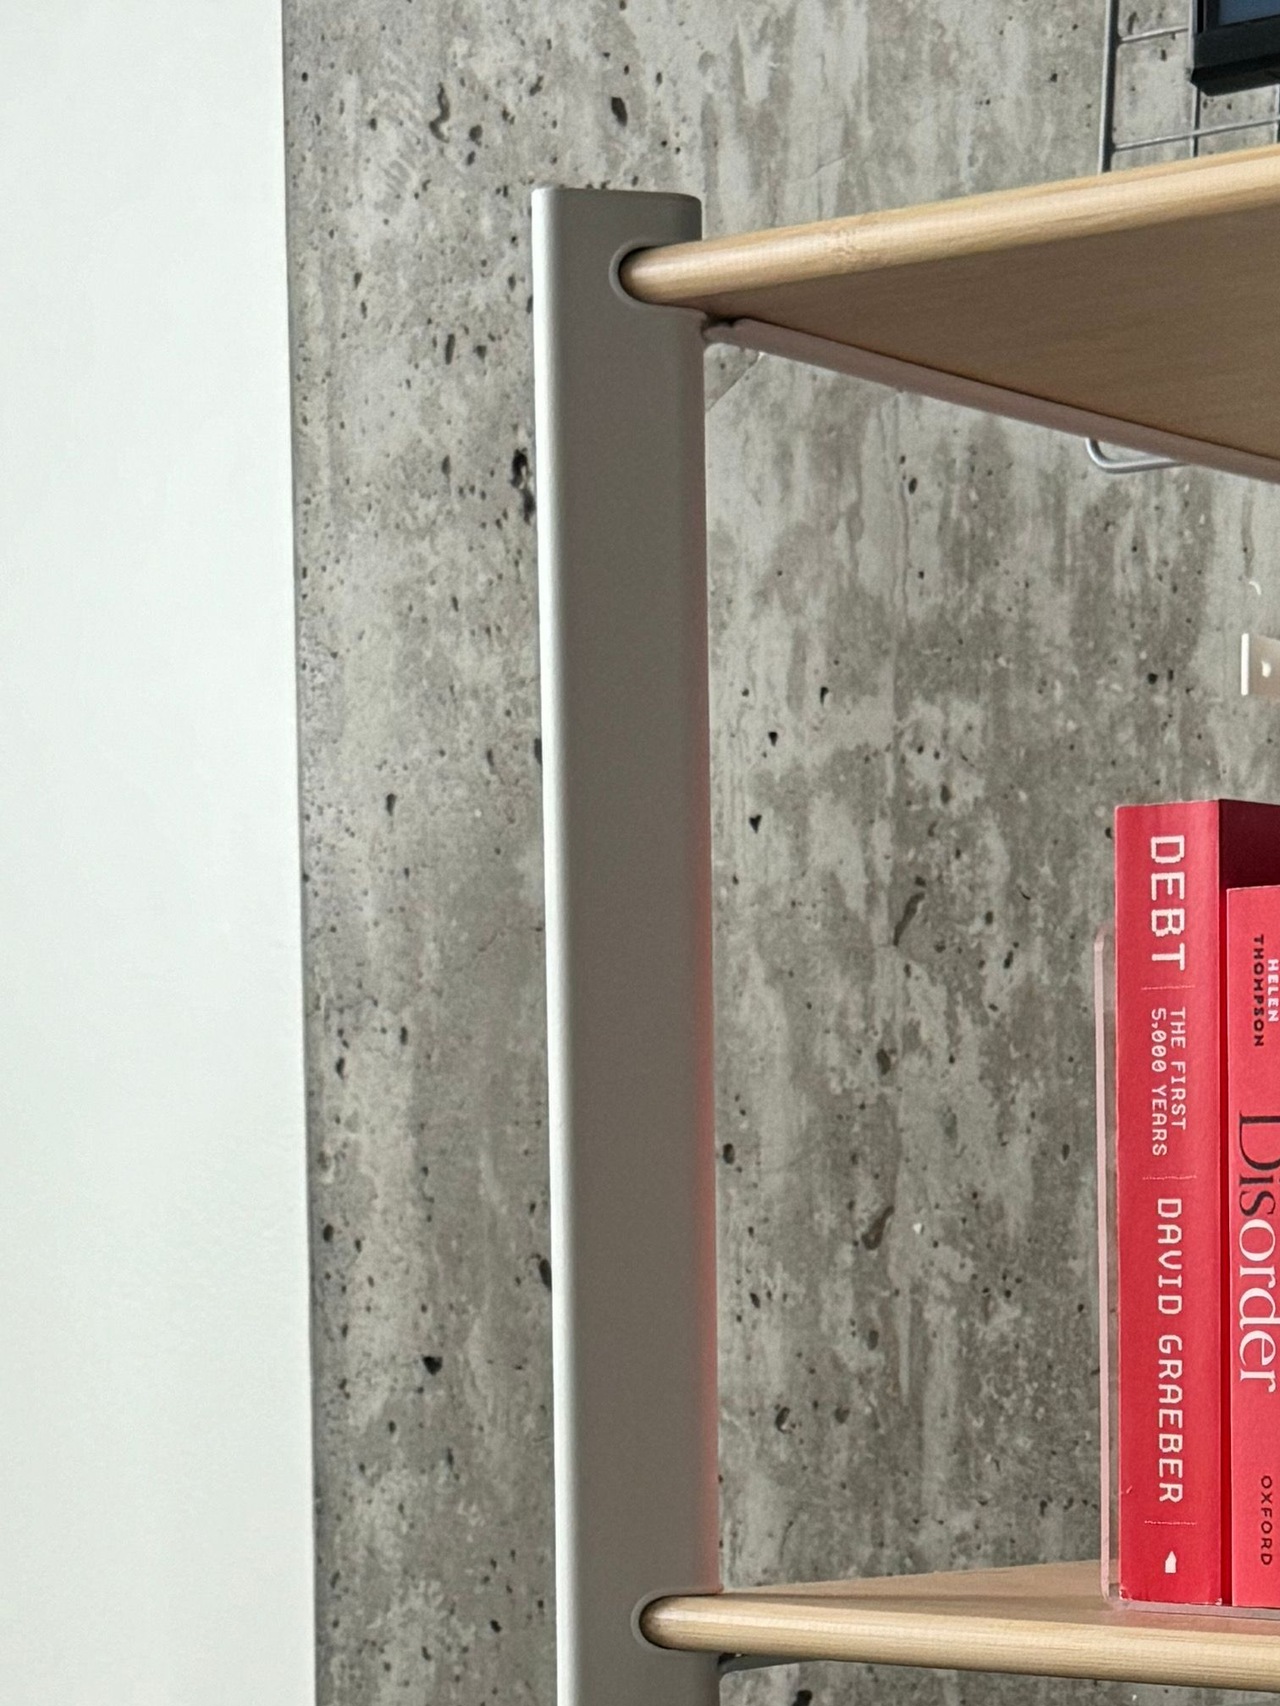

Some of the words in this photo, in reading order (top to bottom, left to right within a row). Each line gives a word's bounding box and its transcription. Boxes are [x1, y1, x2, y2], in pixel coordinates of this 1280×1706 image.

[1150, 834, 1186, 971] DEBT
[1170, 1006, 1187, 1051] THE
[1253, 934, 1265, 1047] THOMPSON
[1267, 958, 1280, 1023] HELEN
[1151, 1007, 1168, 1073] 5,000
[1151, 1083, 1168, 1157] YEARS
[1170, 1060, 1187, 1131] FIRST
[1157, 1198, 1183, 1316] DAVID
[1158, 1334, 1184, 1503] GRAEBER
[1260, 1475, 1273, 1566] OXFORD
